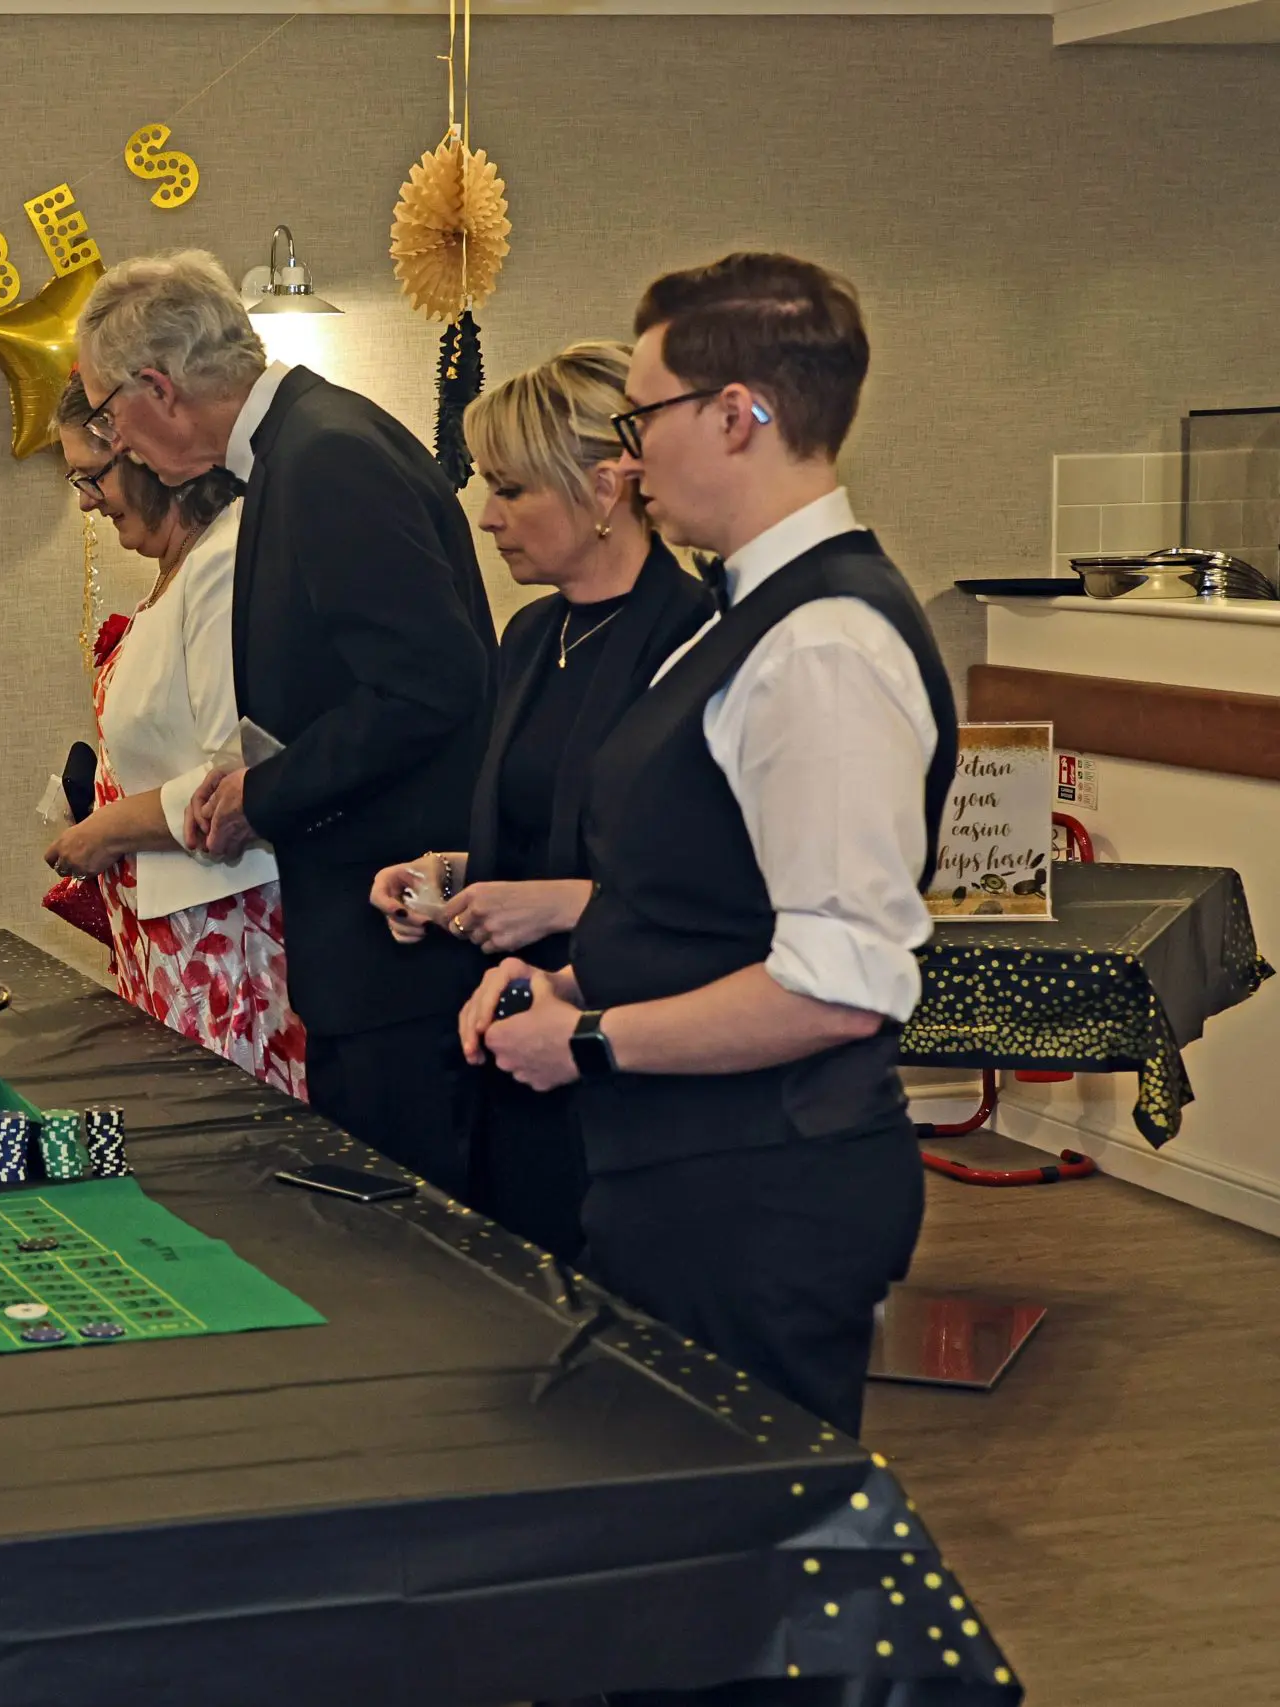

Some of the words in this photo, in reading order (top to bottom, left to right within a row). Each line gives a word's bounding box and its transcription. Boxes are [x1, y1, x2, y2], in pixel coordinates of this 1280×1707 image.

[952, 792, 1001, 821] your
[951, 821, 1013, 842] casino
[936, 845, 982, 880] hips
[986, 845, 1033, 871] here!
